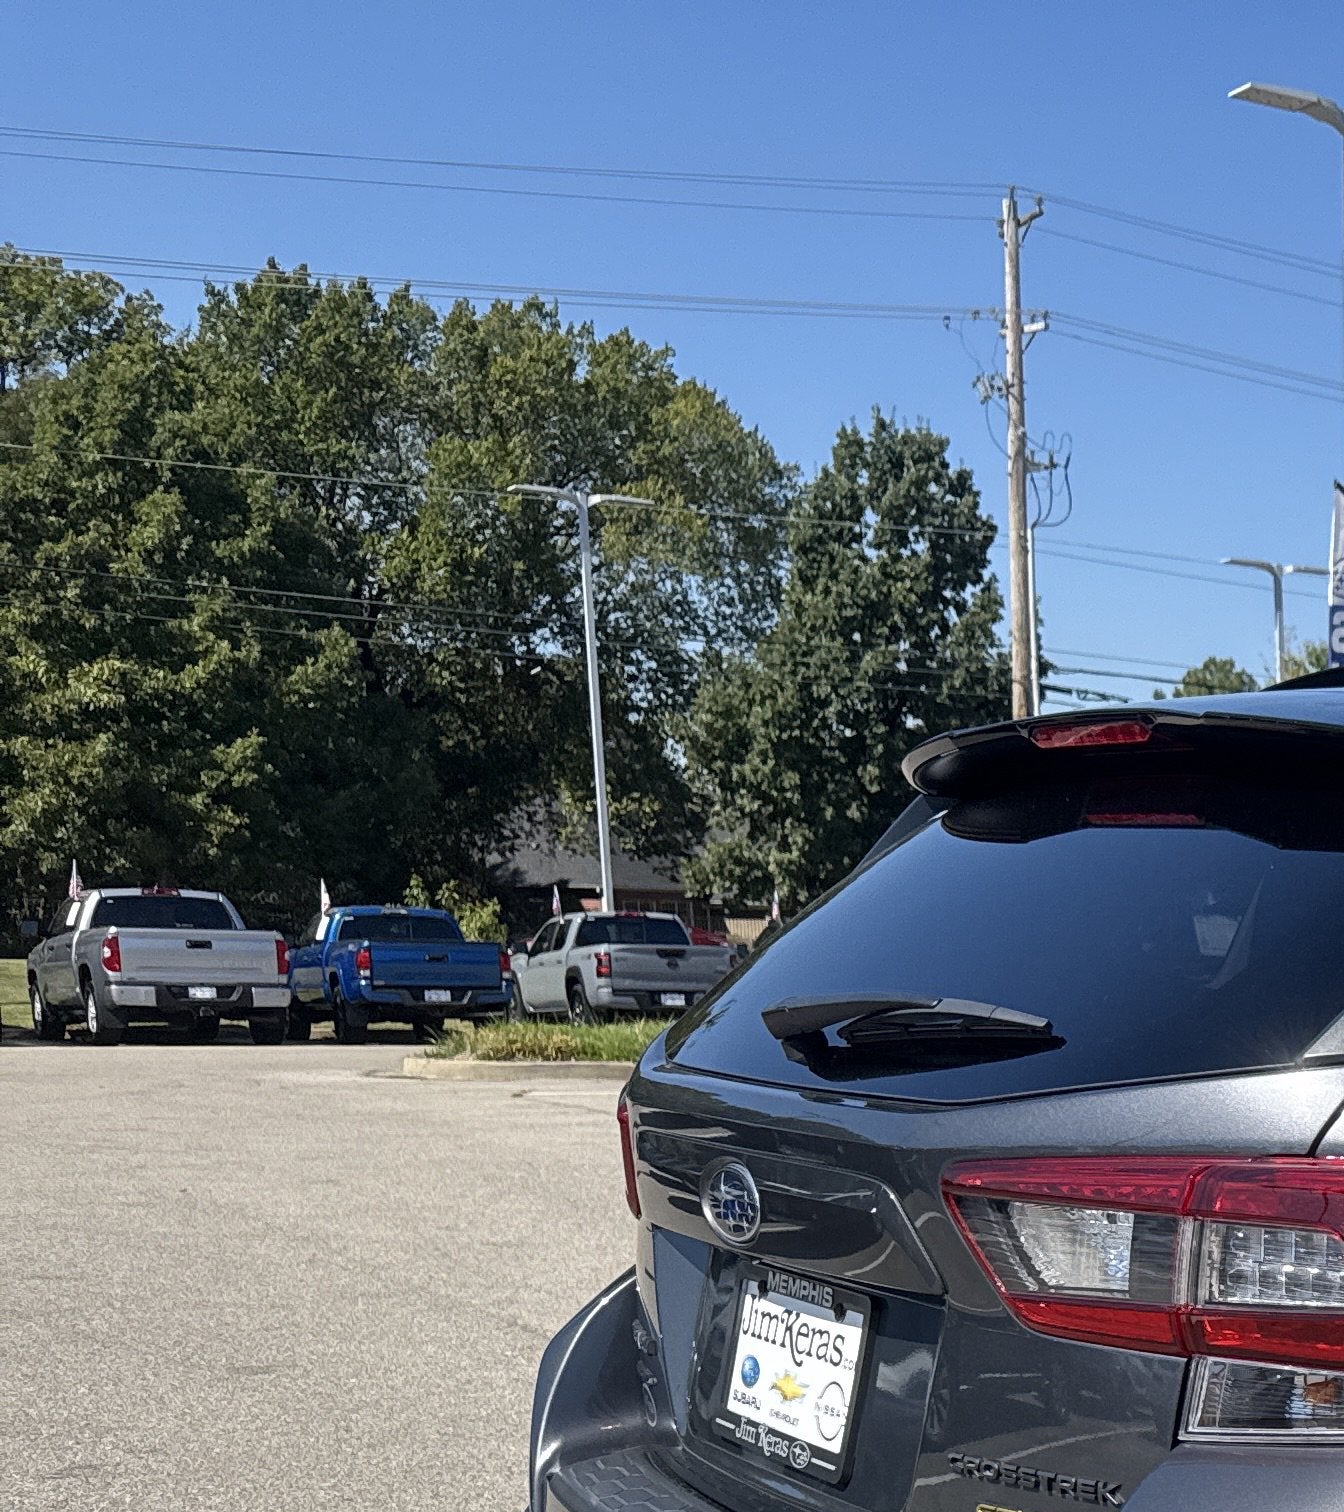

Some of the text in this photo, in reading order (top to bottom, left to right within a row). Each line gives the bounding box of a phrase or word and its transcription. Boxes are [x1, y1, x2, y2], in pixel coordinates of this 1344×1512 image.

[767, 1270, 834, 1309] MEMPHIS
[735, 1416, 790, 1457] Jim Keras
[948, 1453, 1125, 1507] CROSSTREK
